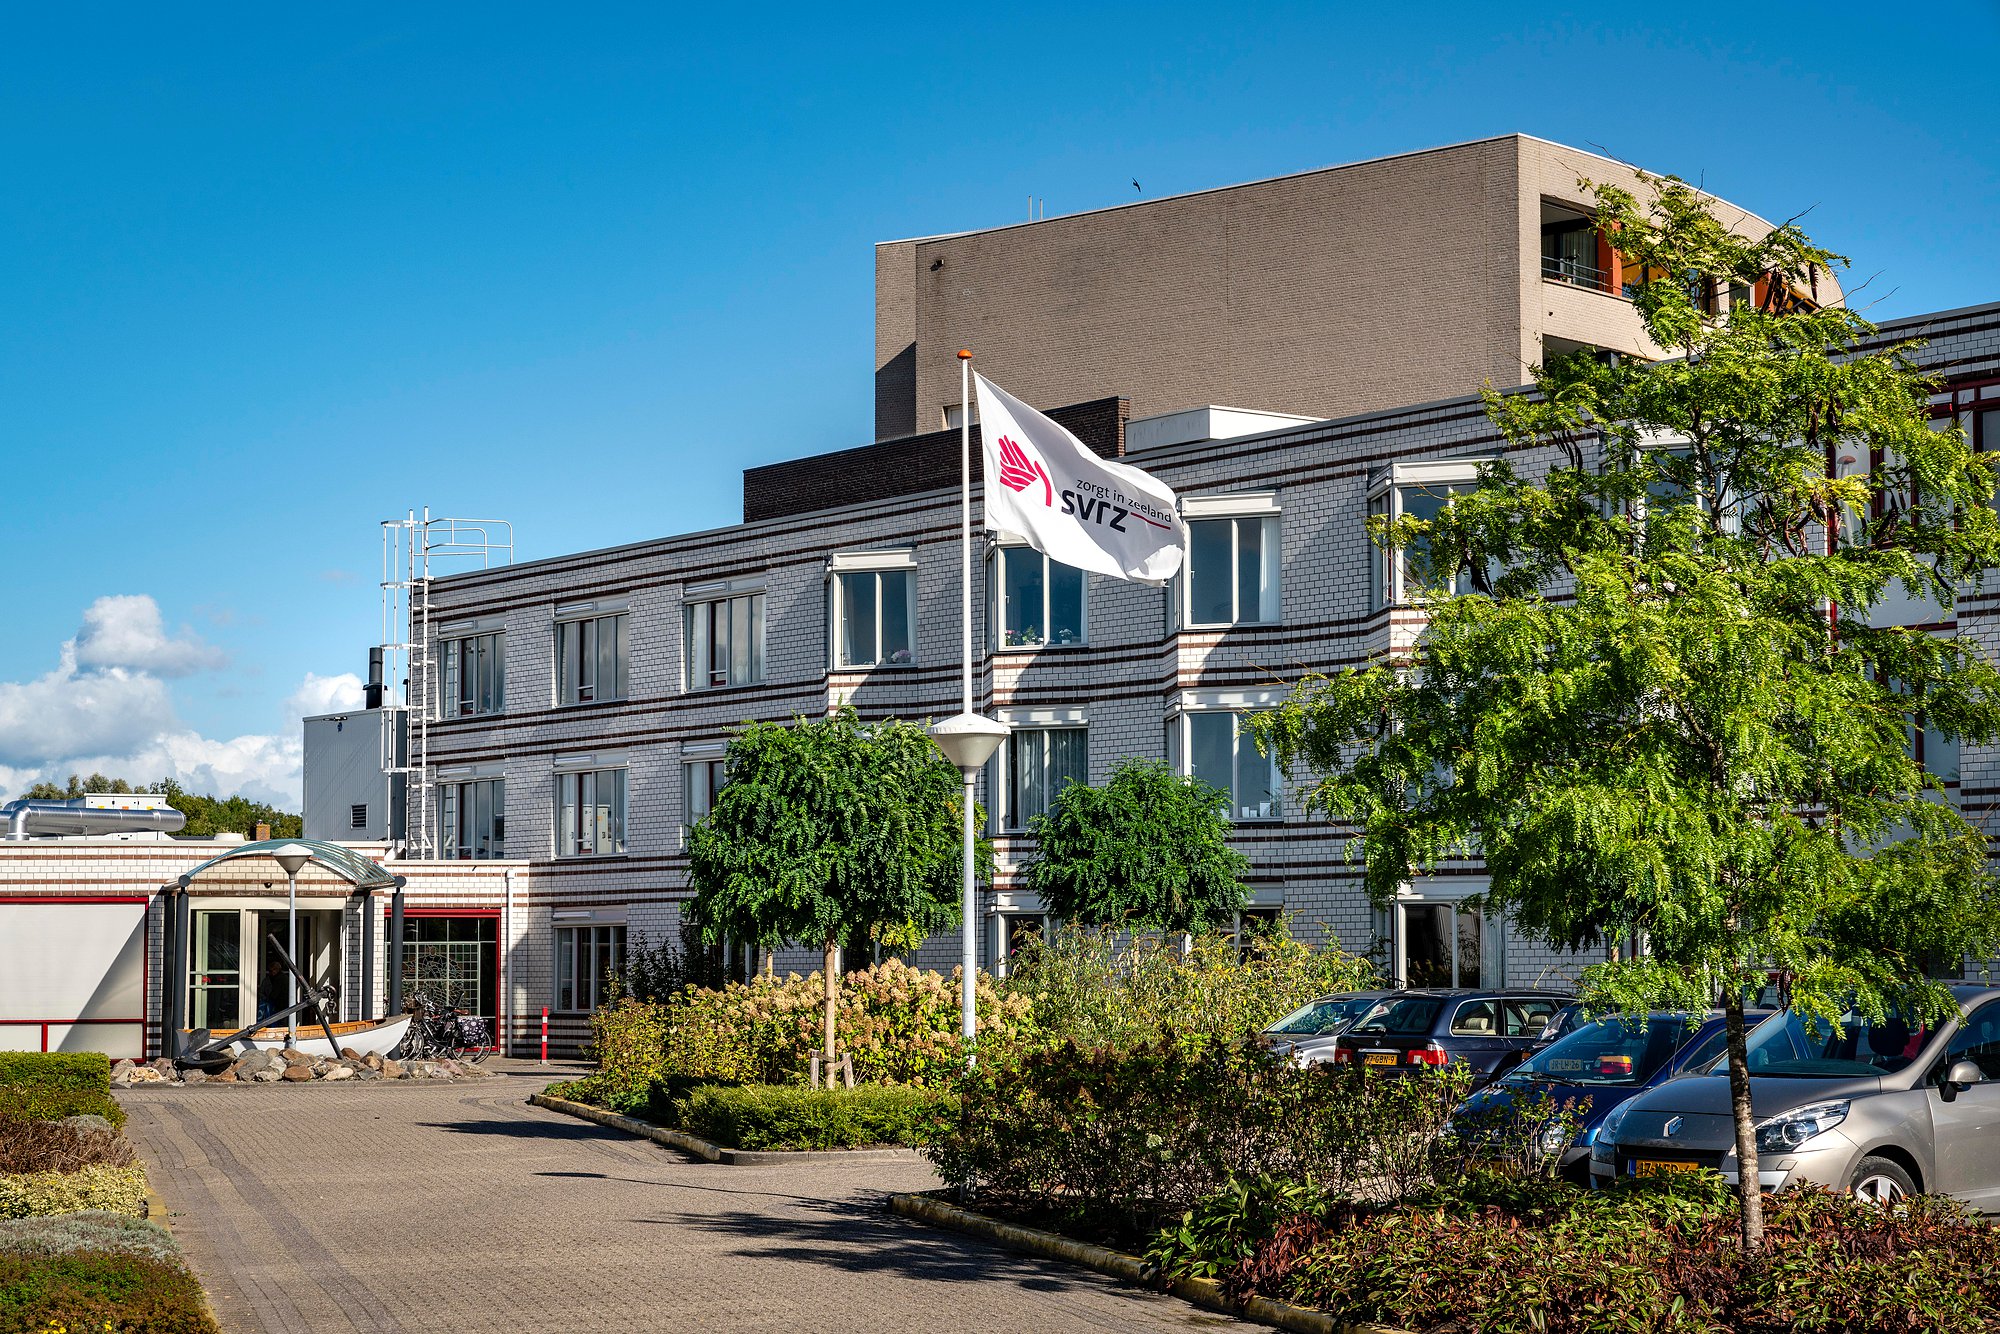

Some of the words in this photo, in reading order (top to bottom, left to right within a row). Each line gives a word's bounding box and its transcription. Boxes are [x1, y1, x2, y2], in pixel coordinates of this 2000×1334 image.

[1061, 489, 1129, 533] svrz
[1076, 479, 1109, 498] zorgt
[1113, 489, 1125, 503] in
[1127, 498, 1172, 523] zeeland
